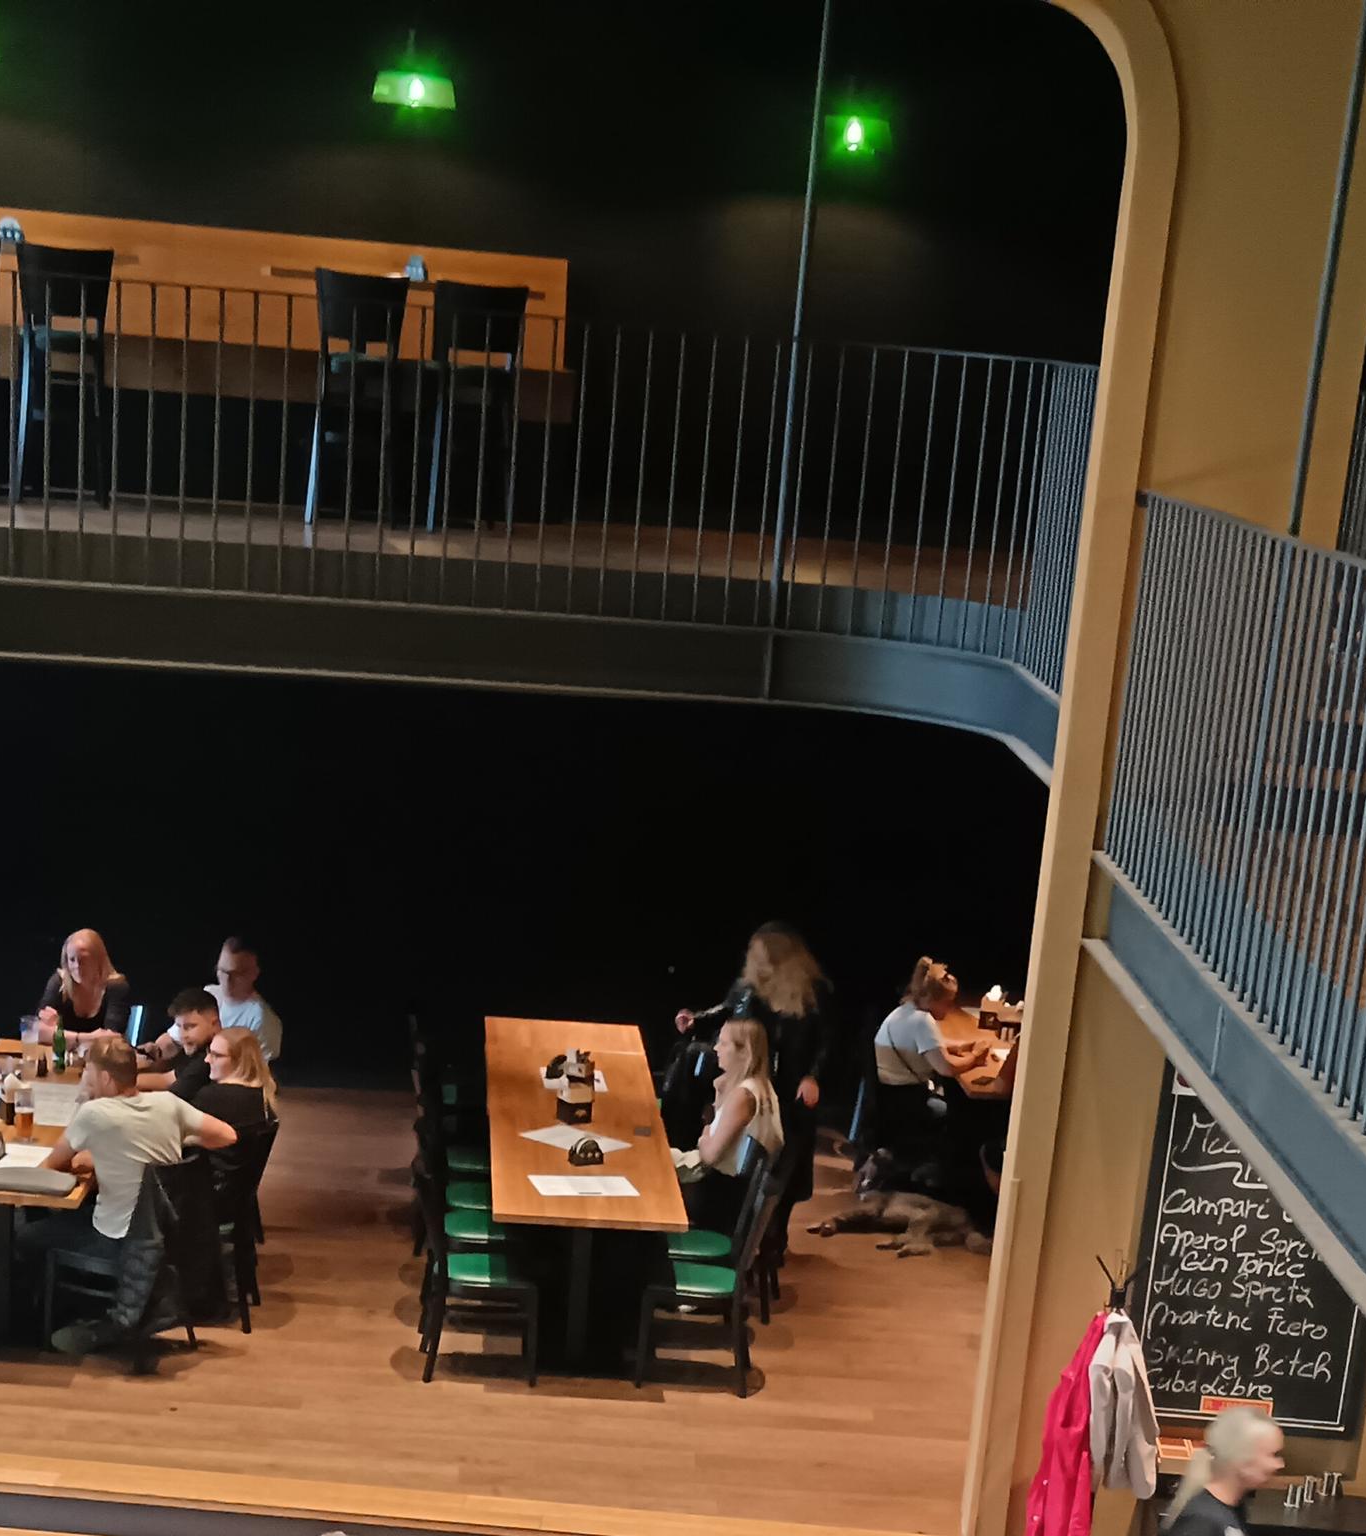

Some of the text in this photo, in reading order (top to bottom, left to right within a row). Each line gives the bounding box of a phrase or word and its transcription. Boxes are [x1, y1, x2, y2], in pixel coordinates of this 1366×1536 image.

[1162, 1189, 1270, 1225] Campari
[1160, 1223, 1248, 1258] Aperol
[1180, 1251, 1306, 1279] Gin Tonic
[1230, 1273, 1314, 1308] Spritz
[1146, 1301, 1328, 1340] Martini Fiero
[1253, 1343, 1332, 1383] Bitch
